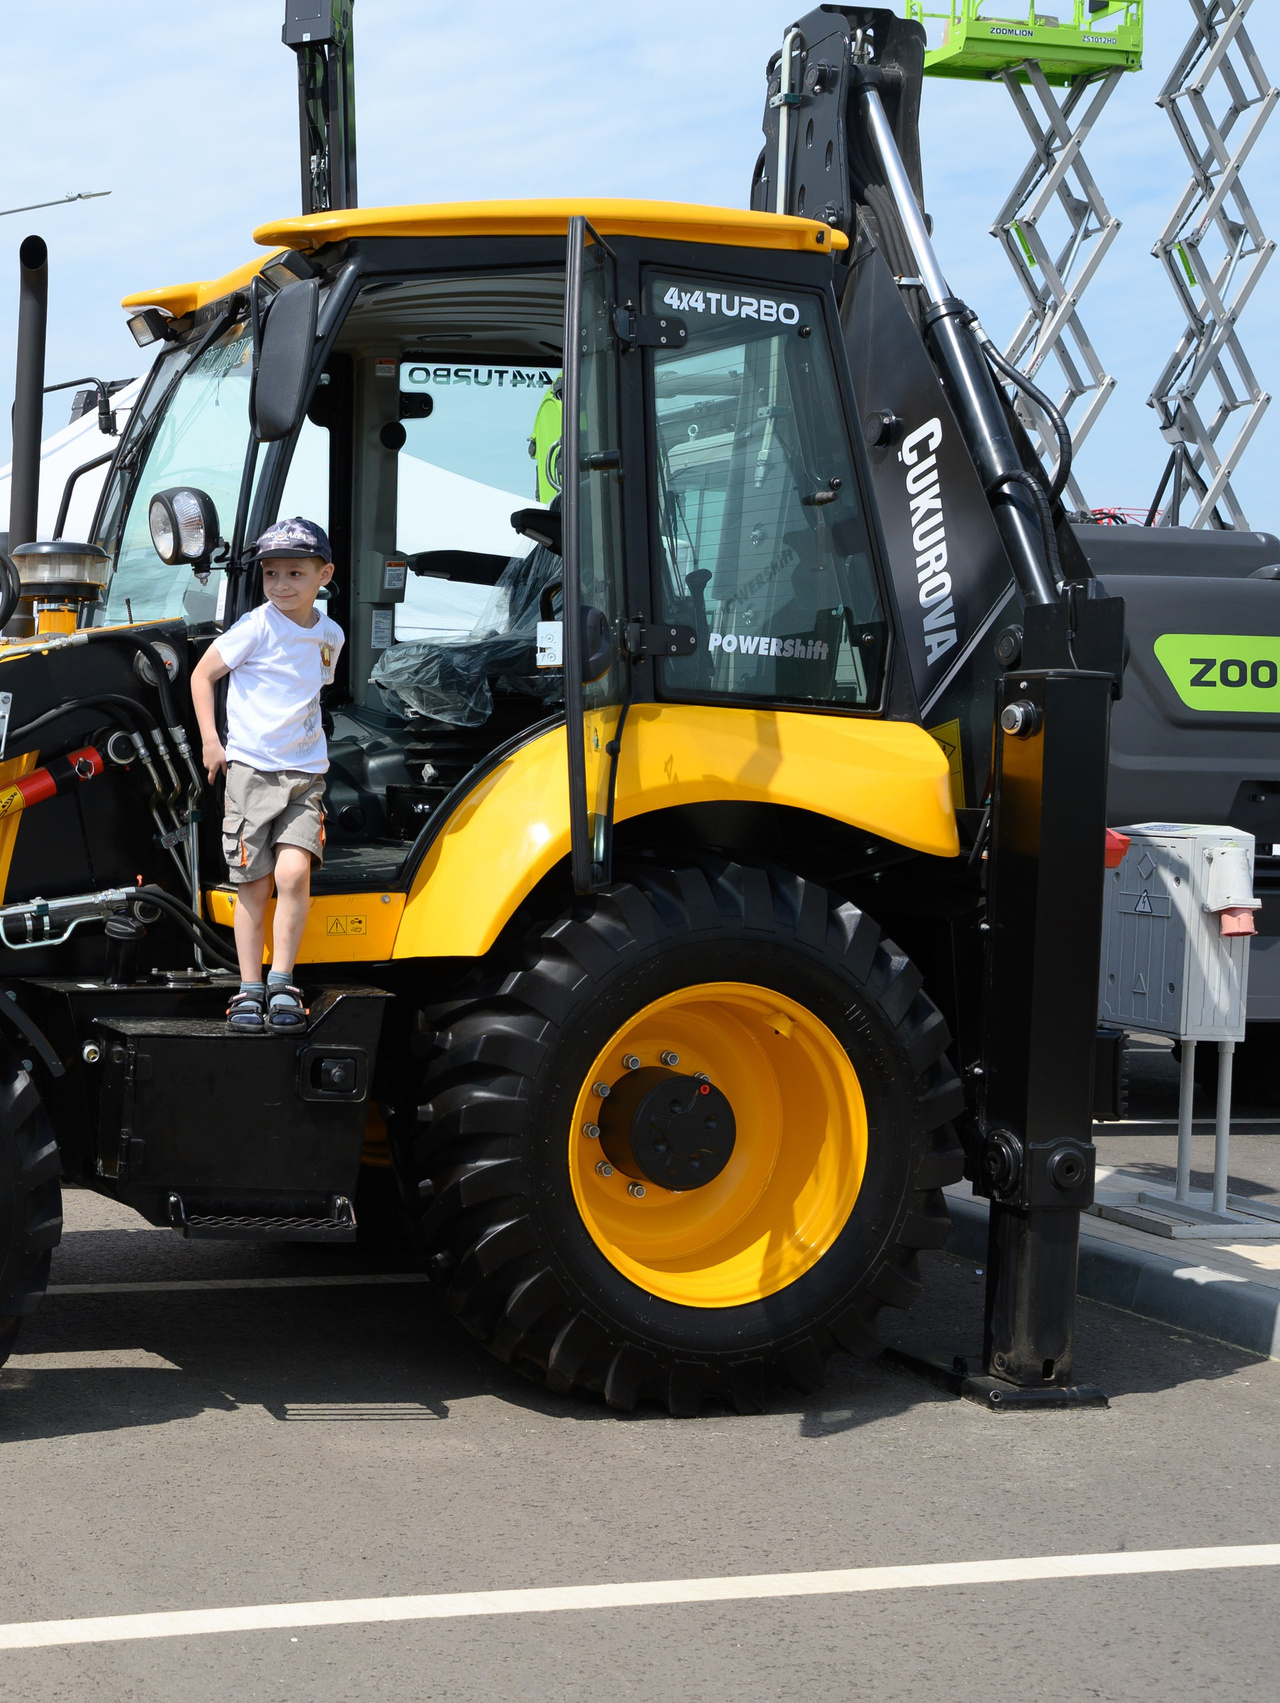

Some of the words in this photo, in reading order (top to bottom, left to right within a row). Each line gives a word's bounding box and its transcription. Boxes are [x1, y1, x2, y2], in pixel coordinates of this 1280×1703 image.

[990, 26, 1033, 38] ZOOMLION
[1082, 34, 1117, 45] ZS1012HD
[897, 416, 958, 667] ÇUKUROVA
[1189, 657, 1278, 689] ZOO
